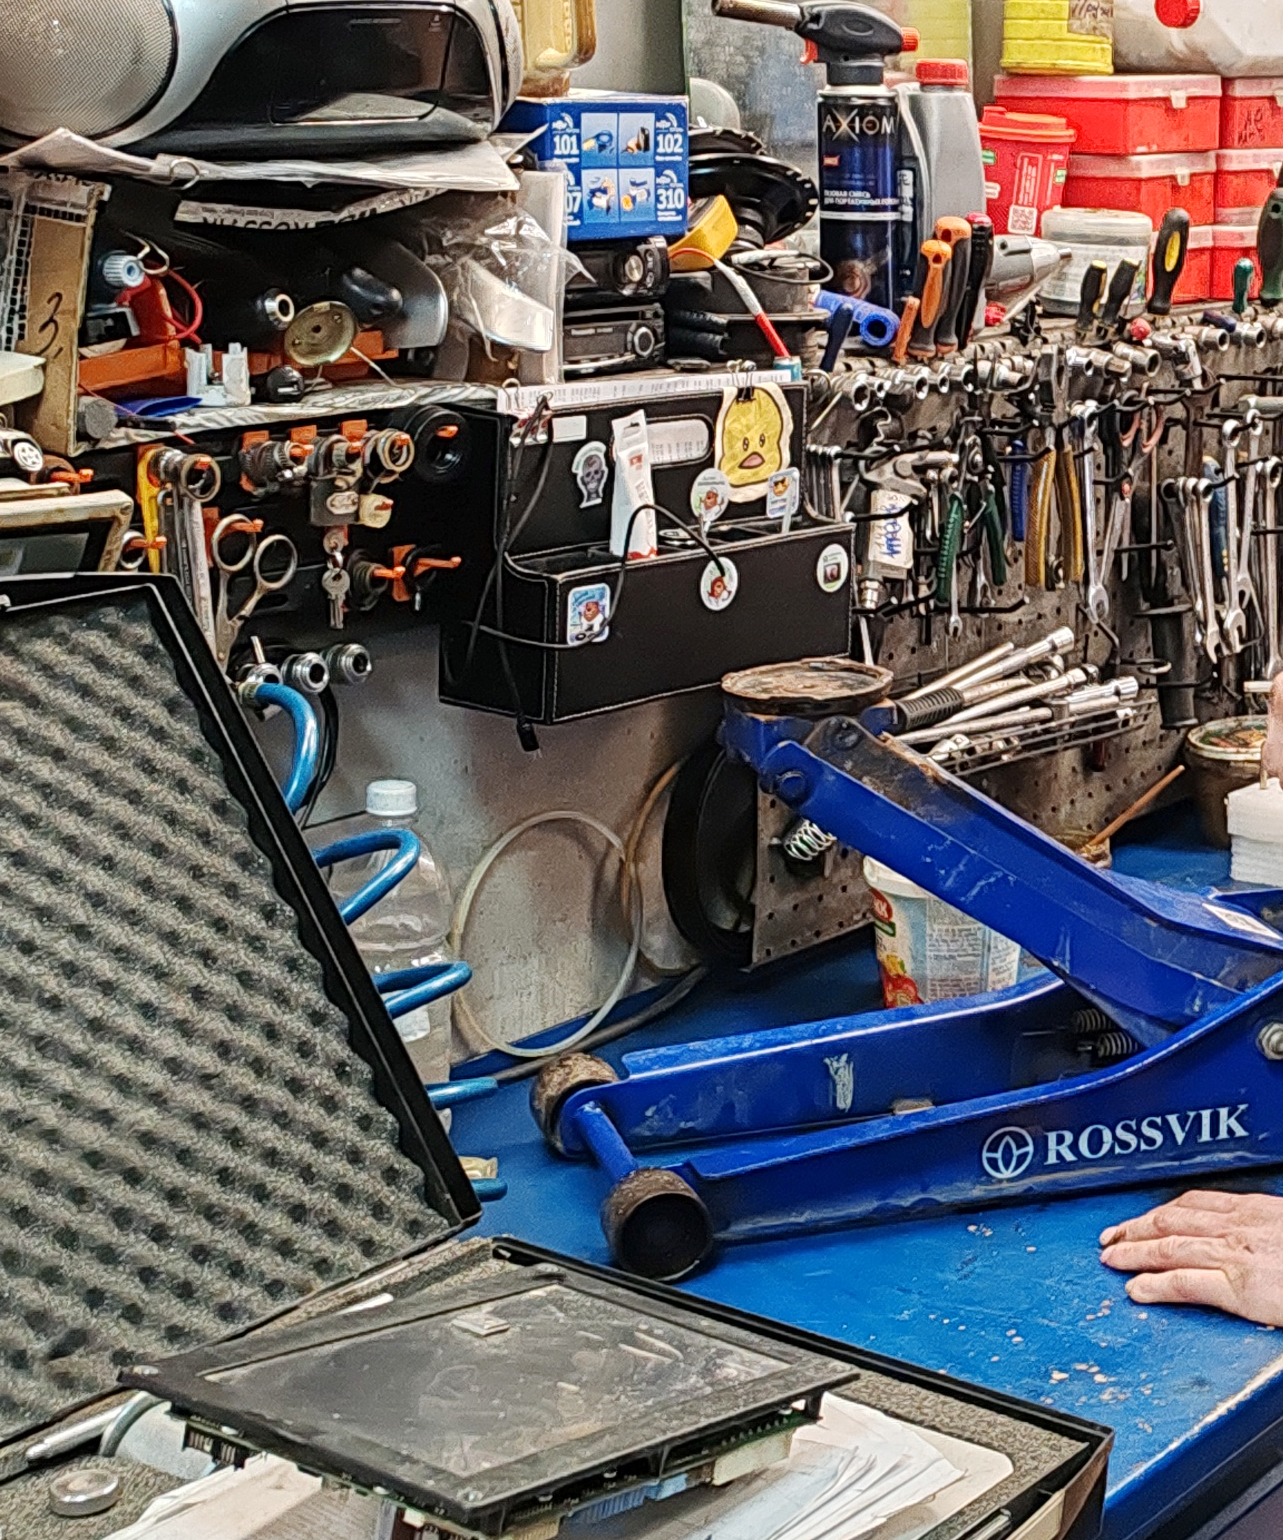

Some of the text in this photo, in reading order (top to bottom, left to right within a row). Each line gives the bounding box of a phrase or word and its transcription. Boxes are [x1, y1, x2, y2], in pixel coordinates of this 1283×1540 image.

[822, 108, 896, 142] AXIOM
[553, 134, 580, 155] 101
[656, 133, 683, 154] 102
[565, 192, 582, 213] 07
[656, 188, 685, 210] 310
[1043, 1103, 1250, 1165] ROSSVIK
